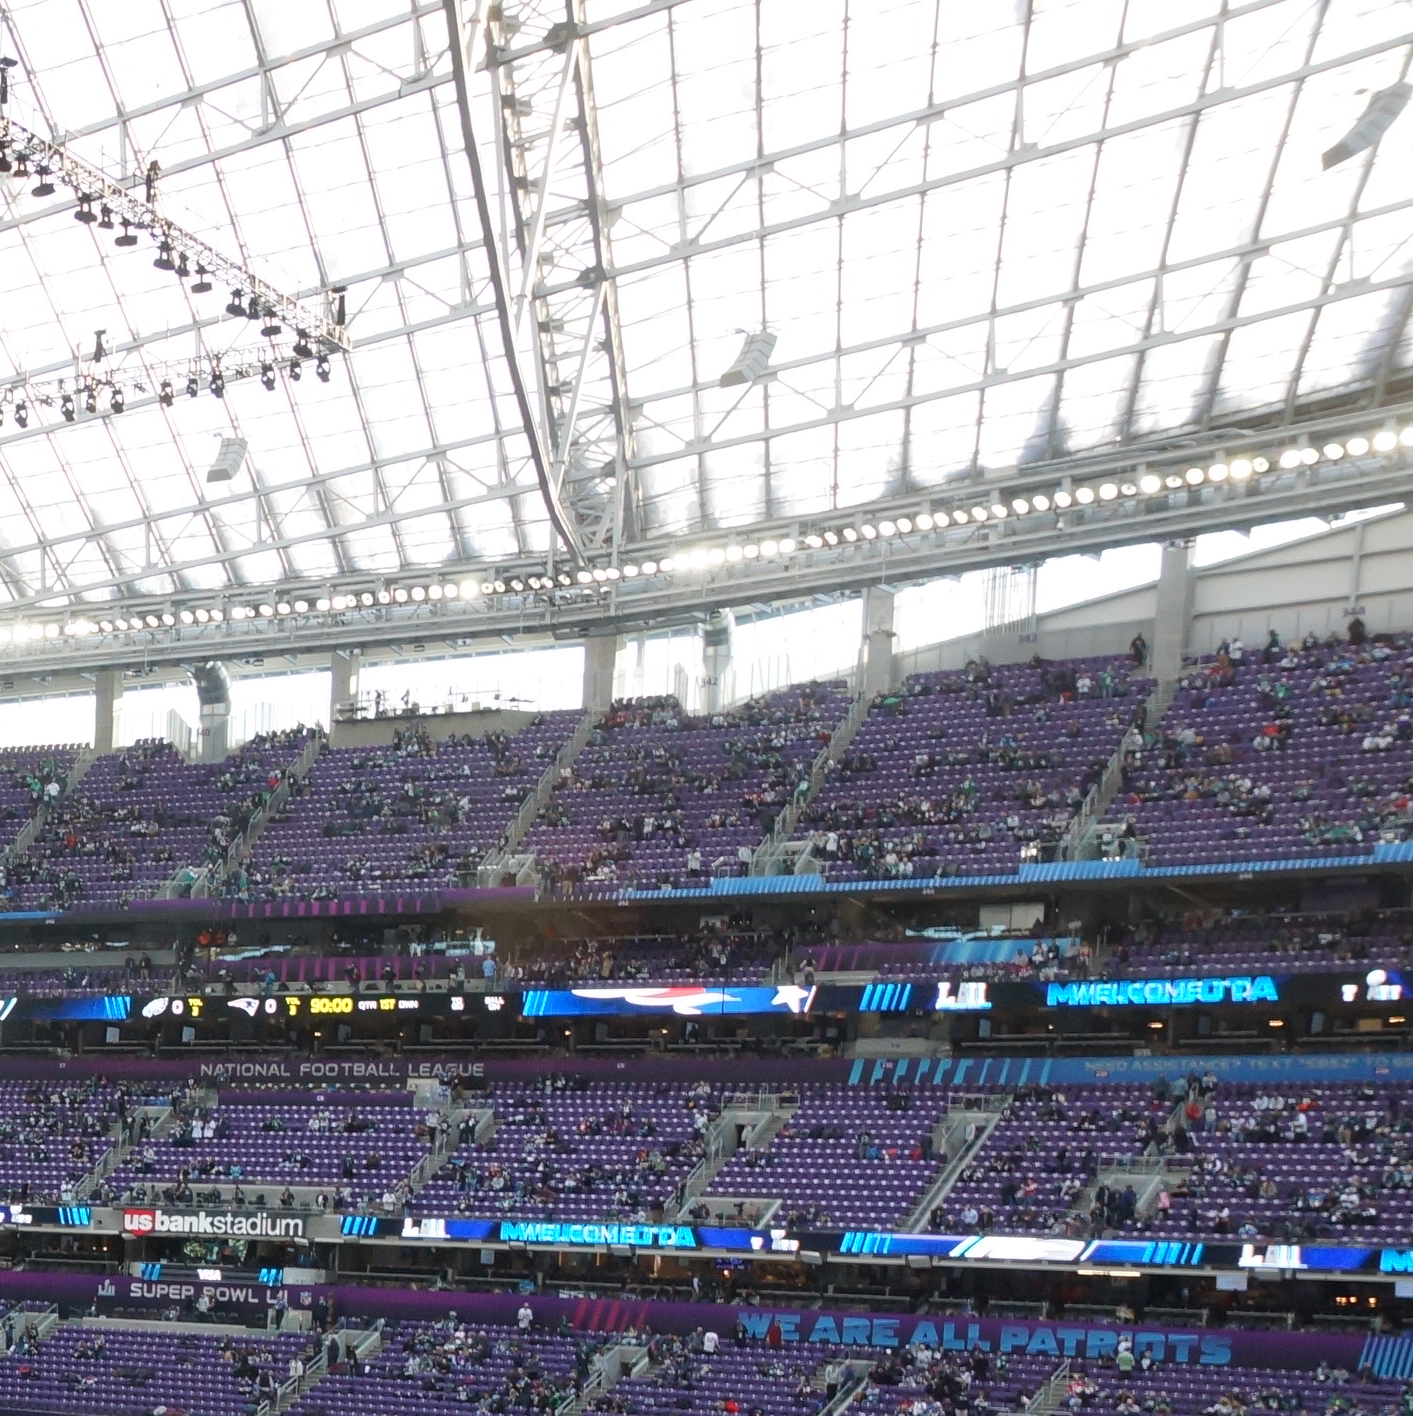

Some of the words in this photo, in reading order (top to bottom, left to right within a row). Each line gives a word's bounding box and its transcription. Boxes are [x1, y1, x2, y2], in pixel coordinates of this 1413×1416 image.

[310, 998, 353, 1013] 90:00
[380, 999, 396, 1010] 1ST
[200, 1062, 290, 1077] NATIONAL
[300, 1062, 400, 1077] FOOTBALL
[408, 1062, 485, 1077] LEAGUE
[198, 1269, 221, 1281] VISA
[130, 1282, 193, 1299] SUPER
[203, 1286, 258, 1303] BOWL
[266, 1289, 288, 1304] LII
[738, 1311, 801, 1342] WE
[809, 1315, 899, 1346] ARE
[911, 1320, 991, 1351] ALL
[999, 1327, 1232, 1365] PATRIOTS
